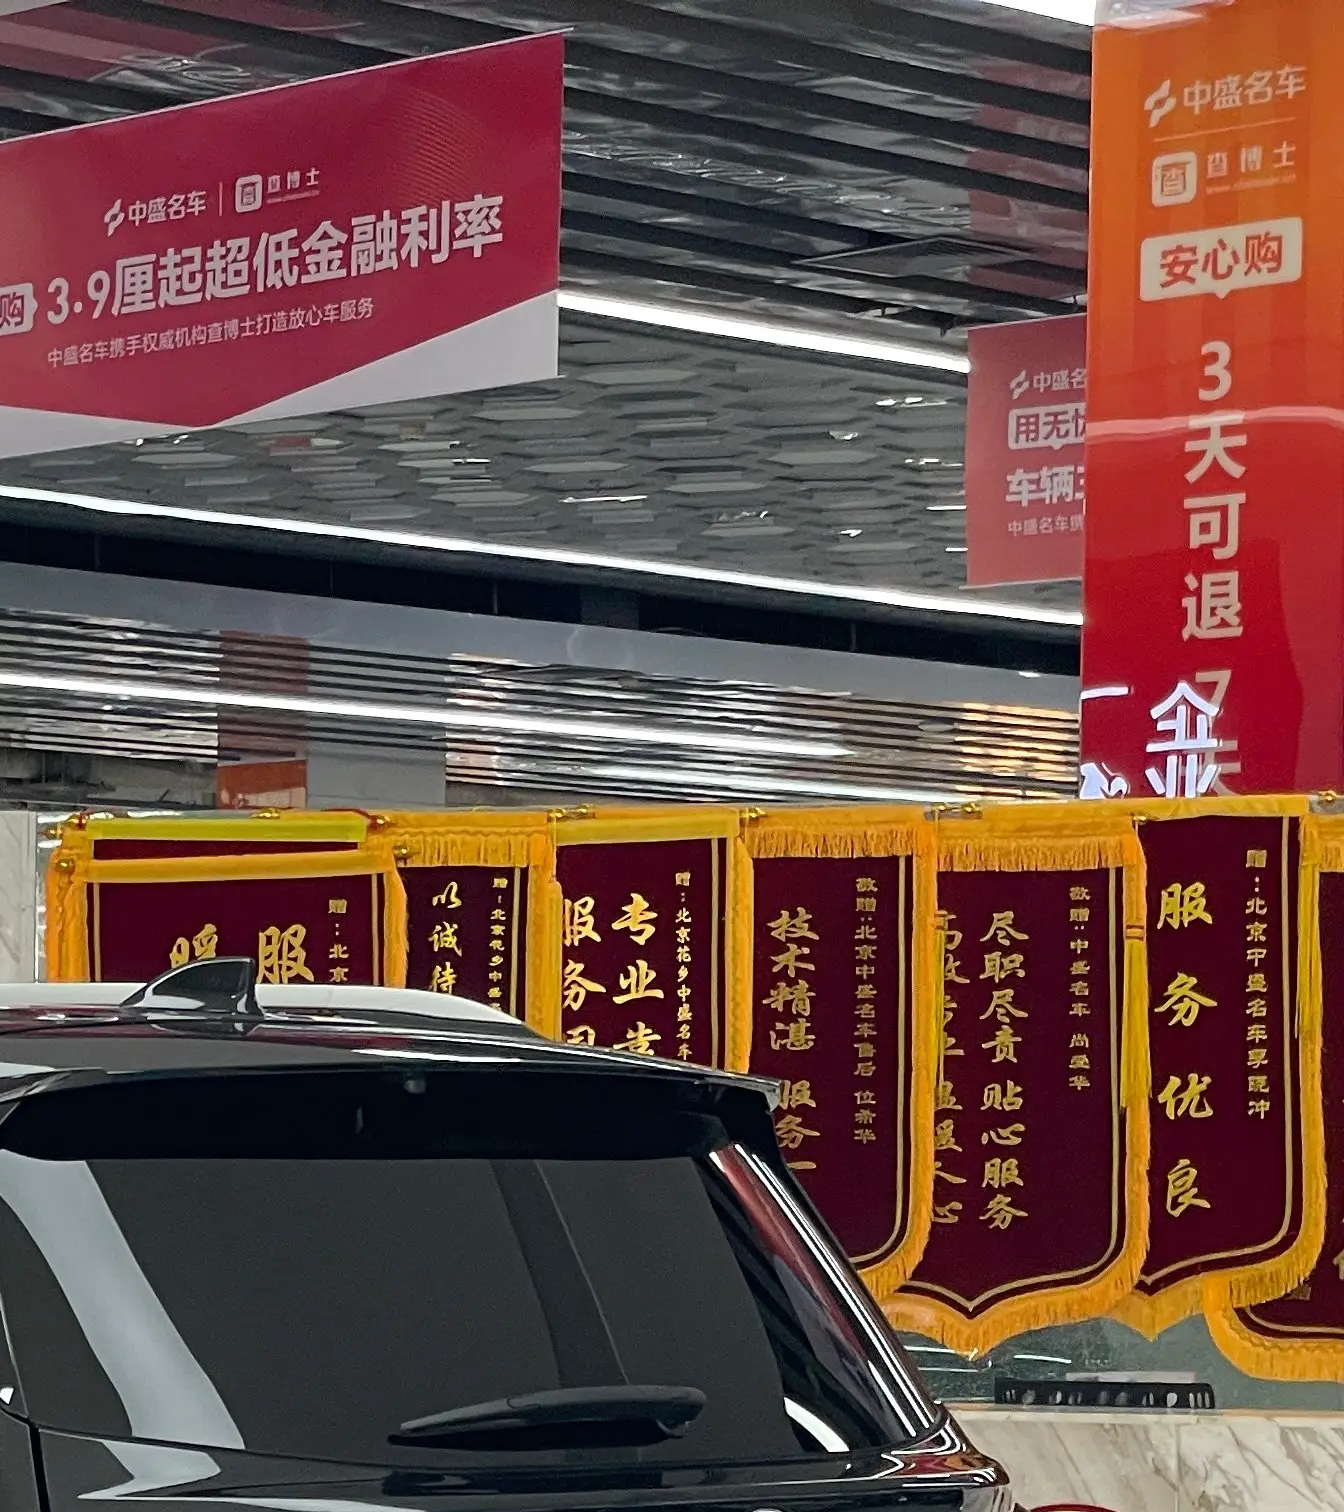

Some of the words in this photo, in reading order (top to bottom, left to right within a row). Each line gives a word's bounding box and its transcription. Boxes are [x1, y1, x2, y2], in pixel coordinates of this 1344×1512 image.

[1183, 65, 1306, 115] 中盛名车
[47, 193, 505, 327] 3.9厘起超低金融利率
[128, 190, 207, 227] 中盛名车
[1159, 230, 1284, 289] 安心购
[1183, 339, 1248, 642] 3天可退
[762, 906, 820, 1051] 技术精湛
[979, 910, 1030, 1064] 尽职尽责
[1149, 881, 1218, 1218] 服务优良
[978, 1079, 1029, 1230] 贴心服务
